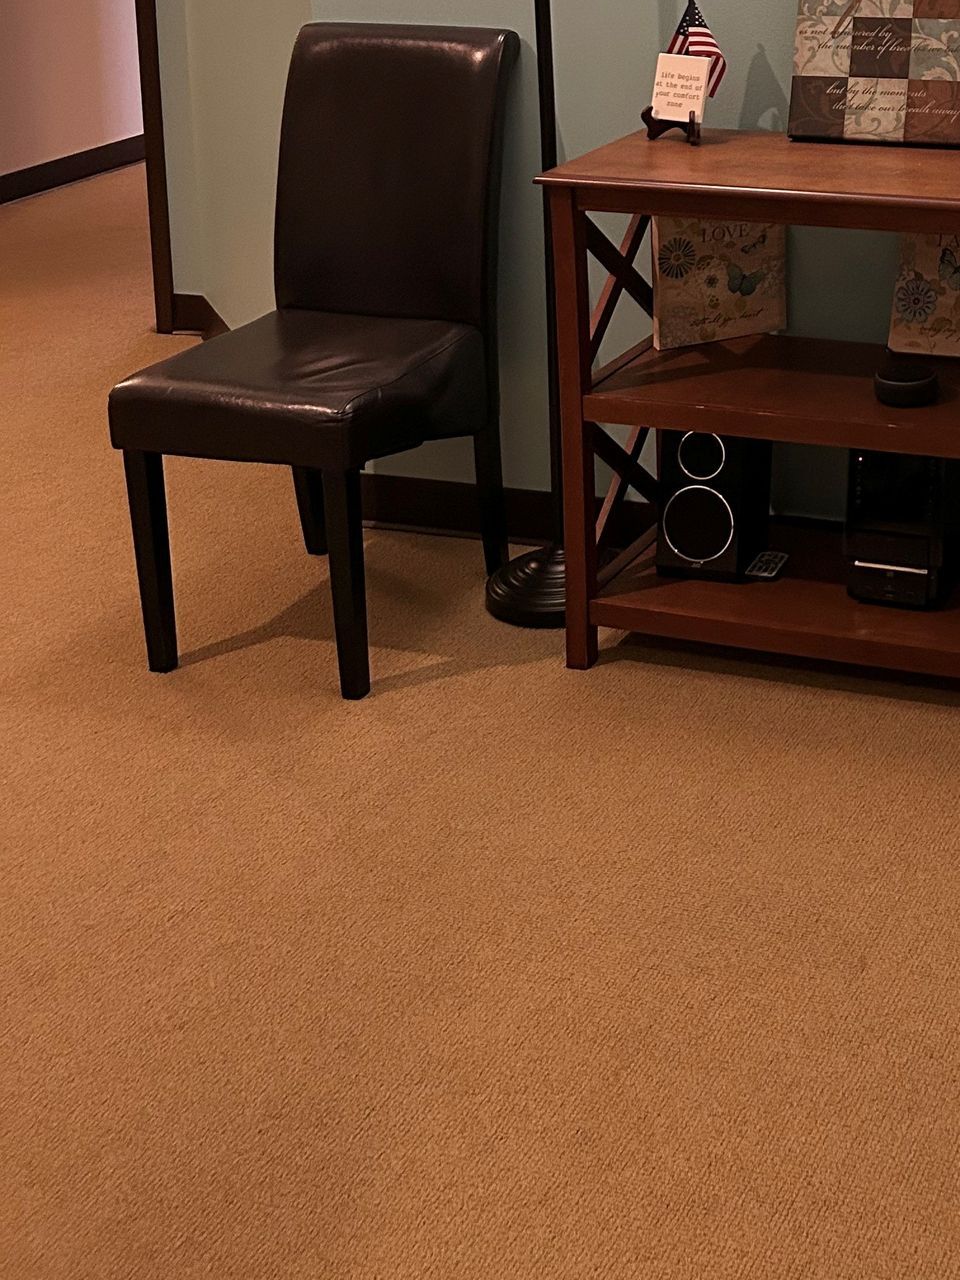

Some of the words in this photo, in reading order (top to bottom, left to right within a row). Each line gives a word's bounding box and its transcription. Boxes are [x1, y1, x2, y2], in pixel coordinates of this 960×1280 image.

[810, 28, 827, 36] not
[877, 24, 893, 45] by
[817, 39, 832, 52] the
[835, 39, 876, 52] number
[876, 39, 894, 60] of
[677, 73, 700, 82] begins
[655, 90, 670, 98] your
[673, 92, 700, 100] comfort
[826, 81, 844, 95] but
[844, 81, 860, 102] by
[862, 83, 877, 95] the
[879, 89, 927, 98] moments
[854, 102, 876, 112] take
[898, 100, 932, 113] breath
[932, 107, 960, 123] away
[701, 222, 750, 243] LOVE
